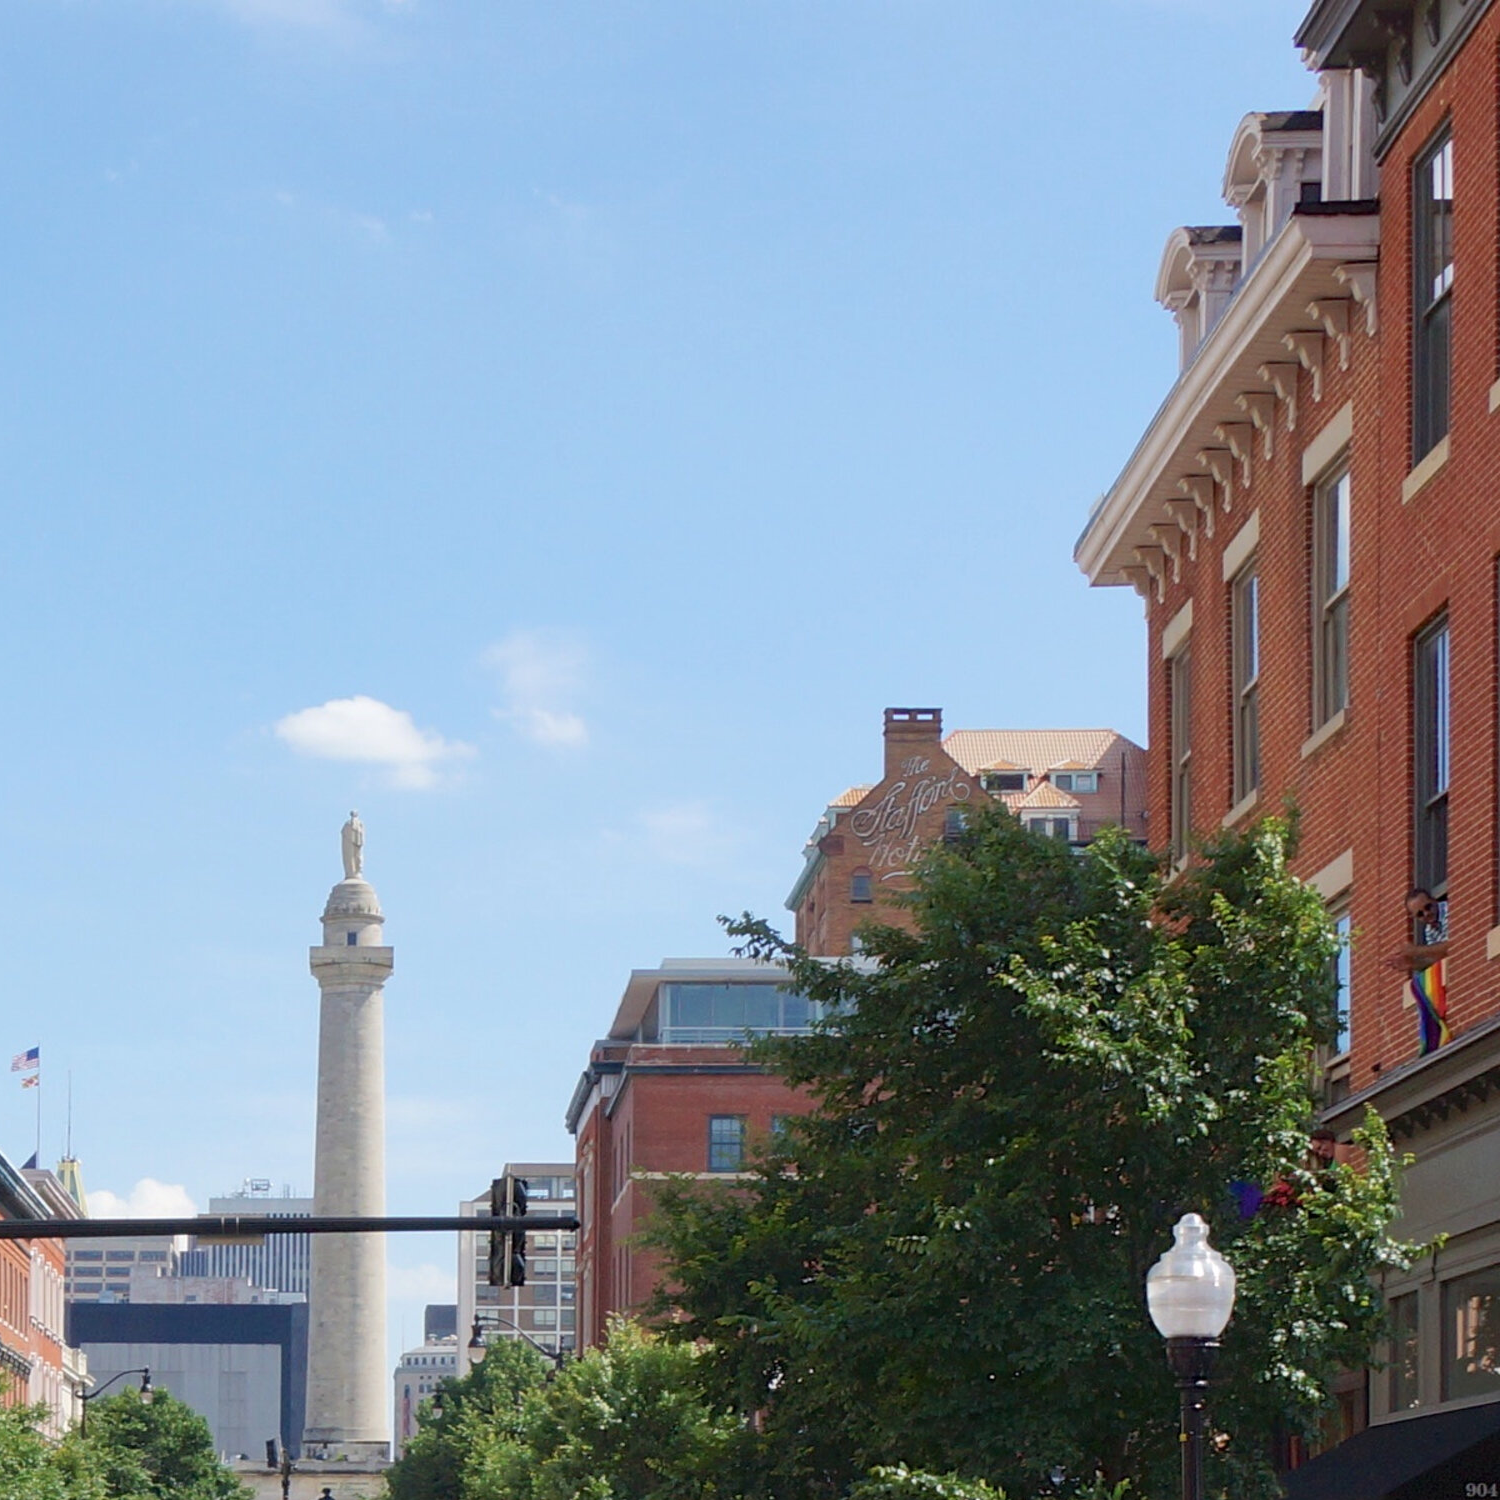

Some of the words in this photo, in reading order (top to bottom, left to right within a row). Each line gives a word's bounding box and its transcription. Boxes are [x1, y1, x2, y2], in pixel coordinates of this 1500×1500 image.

[901, 755, 930, 777] The
[851, 766, 971, 846] Stafford
[1465, 1482, 1499, 1498] 904
